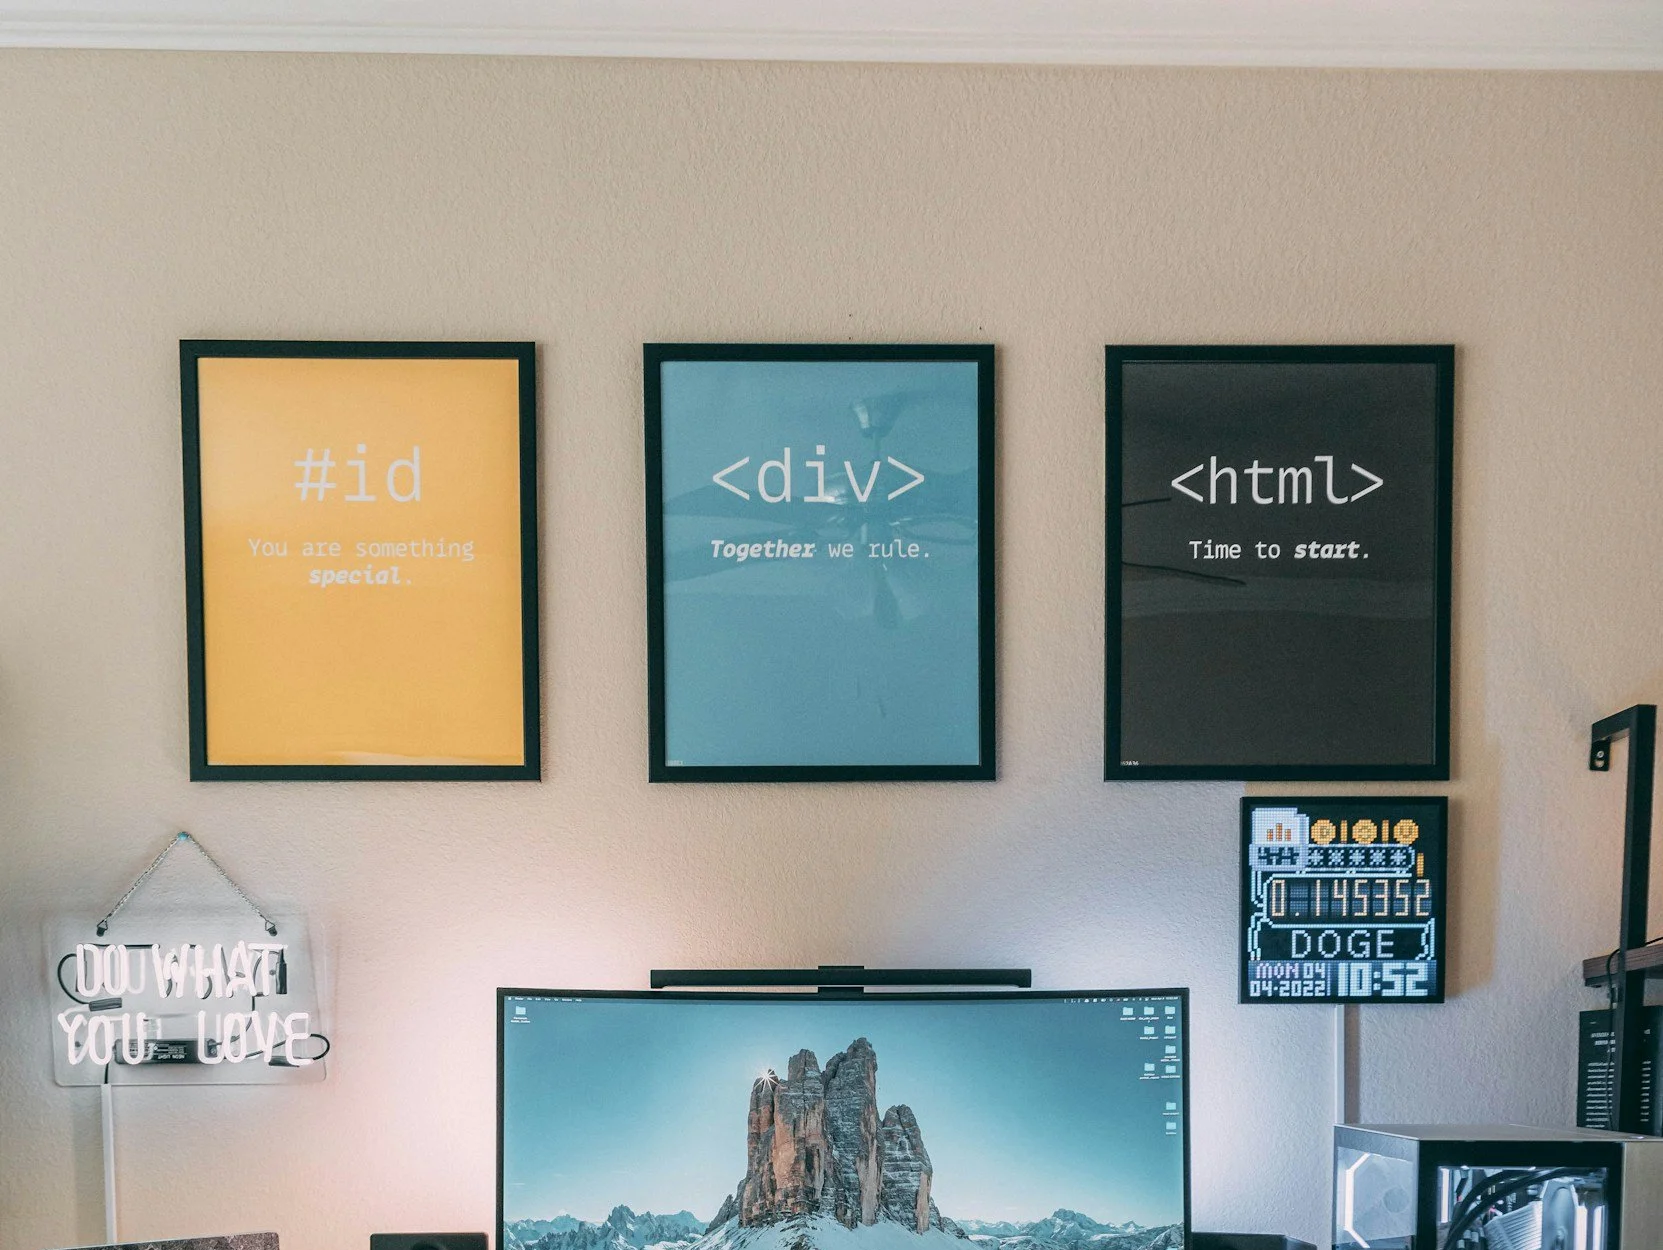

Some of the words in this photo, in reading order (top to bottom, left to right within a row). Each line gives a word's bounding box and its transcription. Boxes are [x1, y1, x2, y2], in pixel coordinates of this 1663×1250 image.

[293, 443, 422, 503] #id
[712, 445, 925, 504] <div>
[1171, 455, 1384, 505] <html>
[248, 538, 288, 558] You
[302, 541, 341, 557] are
[356, 538, 475, 561] something
[711, 539, 816, 562] Together
[828, 543, 854, 558] we
[868, 540, 931, 558] rule.
[1189, 540, 1241, 559] Time
[1255, 541, 1281, 559] to
[1293, 541, 1370, 559] start.
[309, 565, 412, 587] special.
[1291, 929, 1394, 959] DOGE
[77, 943, 128, 996] DO
[151, 940, 288, 998] WHAT
[1256, 963, 1299, 979] MON
[1303, 963, 1326, 979] 04
[1338, 963, 1428, 997] 10:52
[58, 1012, 146, 1065] YOU
[198, 1011, 313, 1065] LOVE
